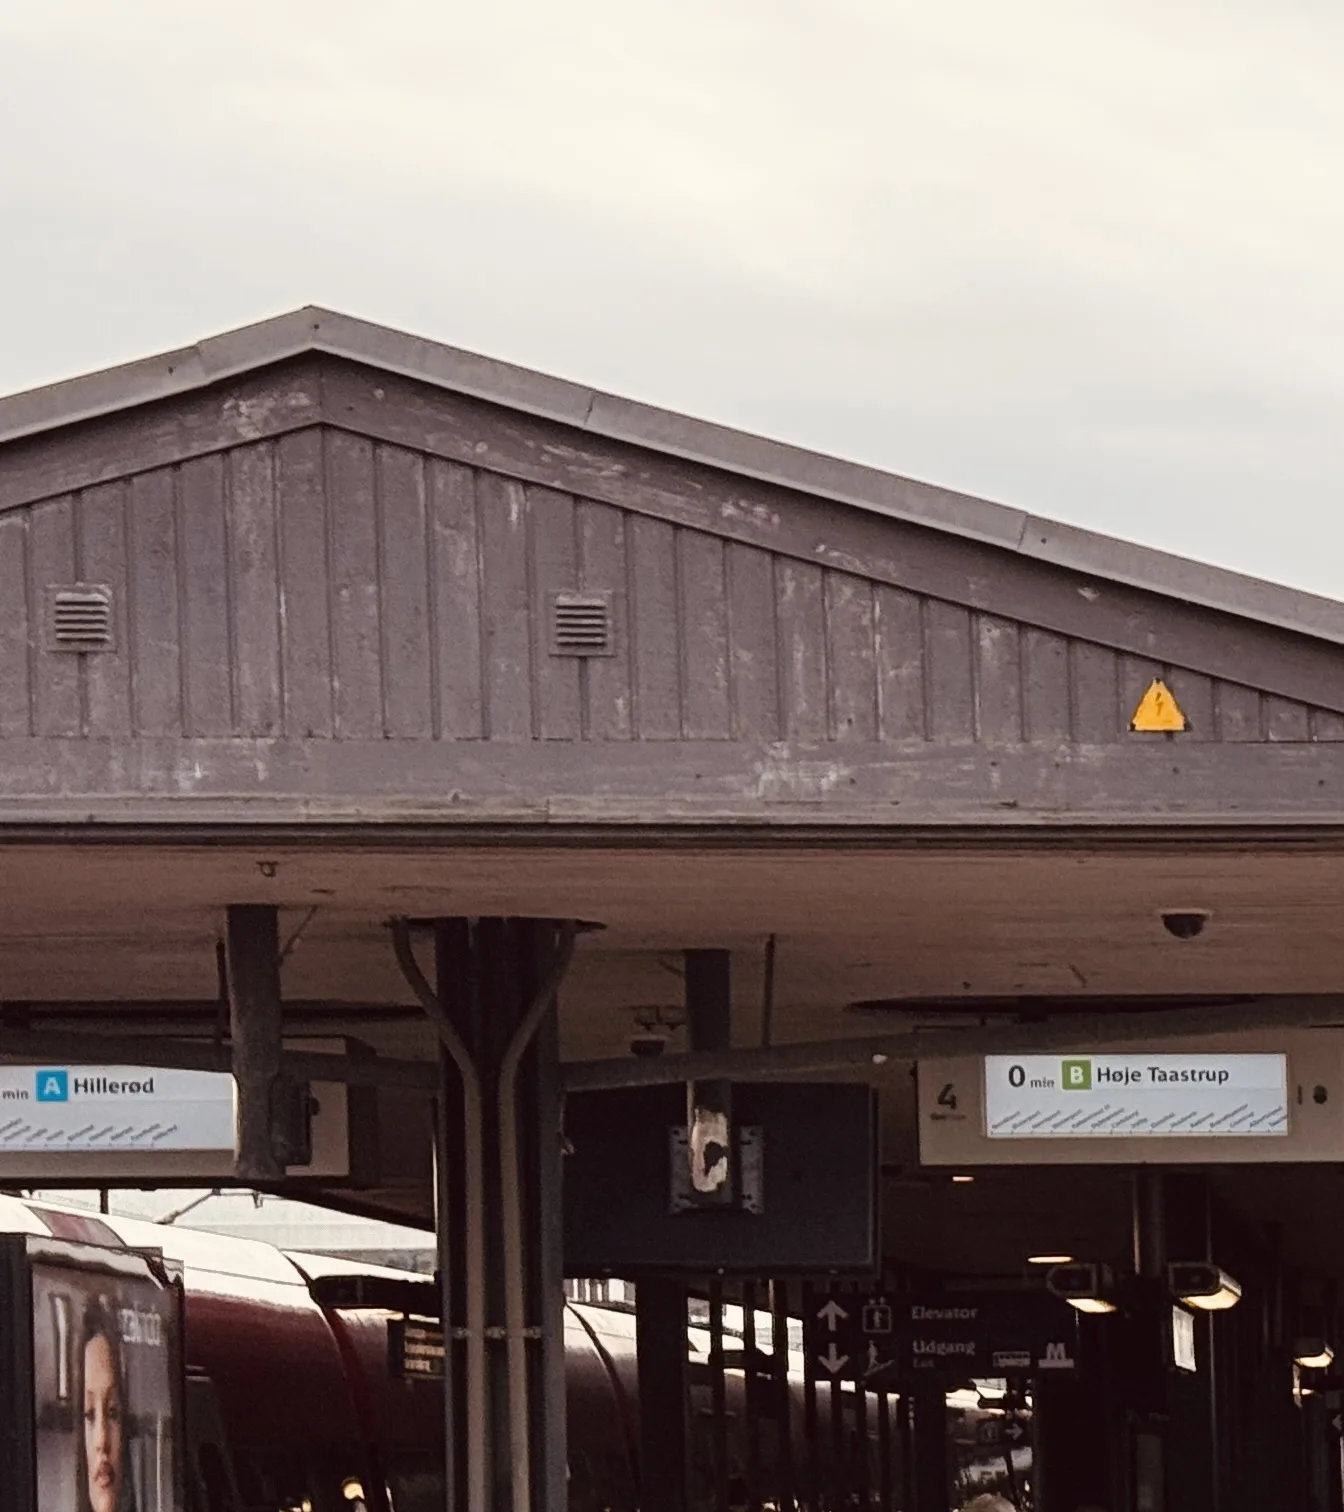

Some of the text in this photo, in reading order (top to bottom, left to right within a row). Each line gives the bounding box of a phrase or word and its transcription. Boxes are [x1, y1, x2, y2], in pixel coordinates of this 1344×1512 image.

[1008, 1065, 1229, 1088] 0 min B Høje Taastrup
[2, 1077, 155, 1100] min A Hillerød
[937, 1083, 957, 1109] 4
[911, 1305, 978, 1320] Elevator
[912, 1339, 976, 1356] Udgang
